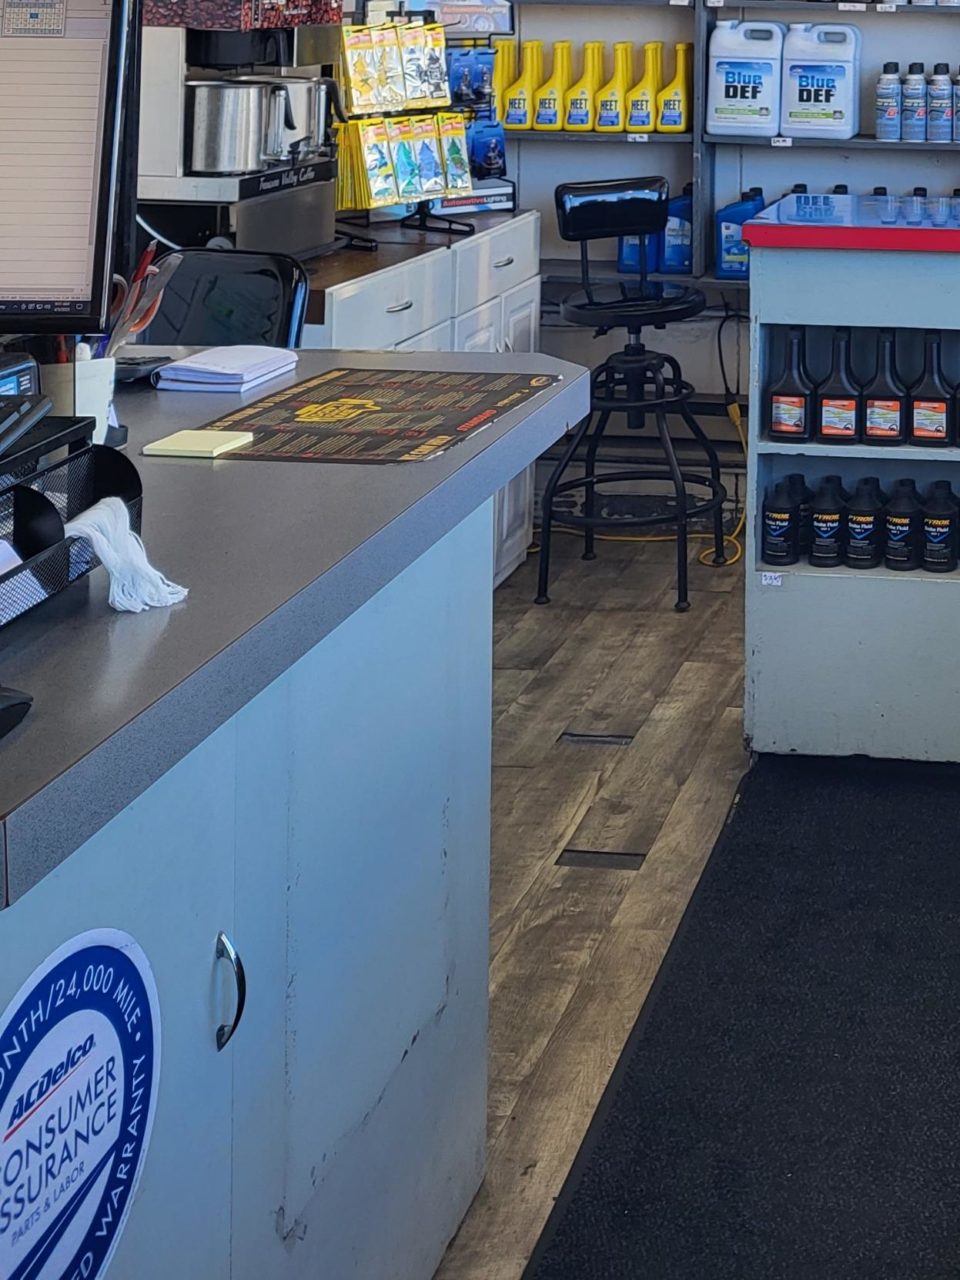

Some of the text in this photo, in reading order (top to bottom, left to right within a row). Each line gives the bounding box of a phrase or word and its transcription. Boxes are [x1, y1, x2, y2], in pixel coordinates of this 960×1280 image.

[724, 71, 762, 86] Blue
[798, 75, 836, 89] Blue
[724, 85, 762, 99] DEF
[798, 88, 835, 103] DEF
[509, 98, 526, 110] HEET
[539, 98, 556, 109] HEET
[570, 98, 588, 109] HEET
[601, 100, 618, 111] HEET
[631, 99, 649, 111] HEET
[663, 99, 681, 110] HEET
[113, 977, 141, 1033] MILE
[7, 1033, 95, 1131] ACDelco
[95, 1054, 147, 1237] WARRANTY
[11, 1160, 85, 1248] PARTS & LABOR
